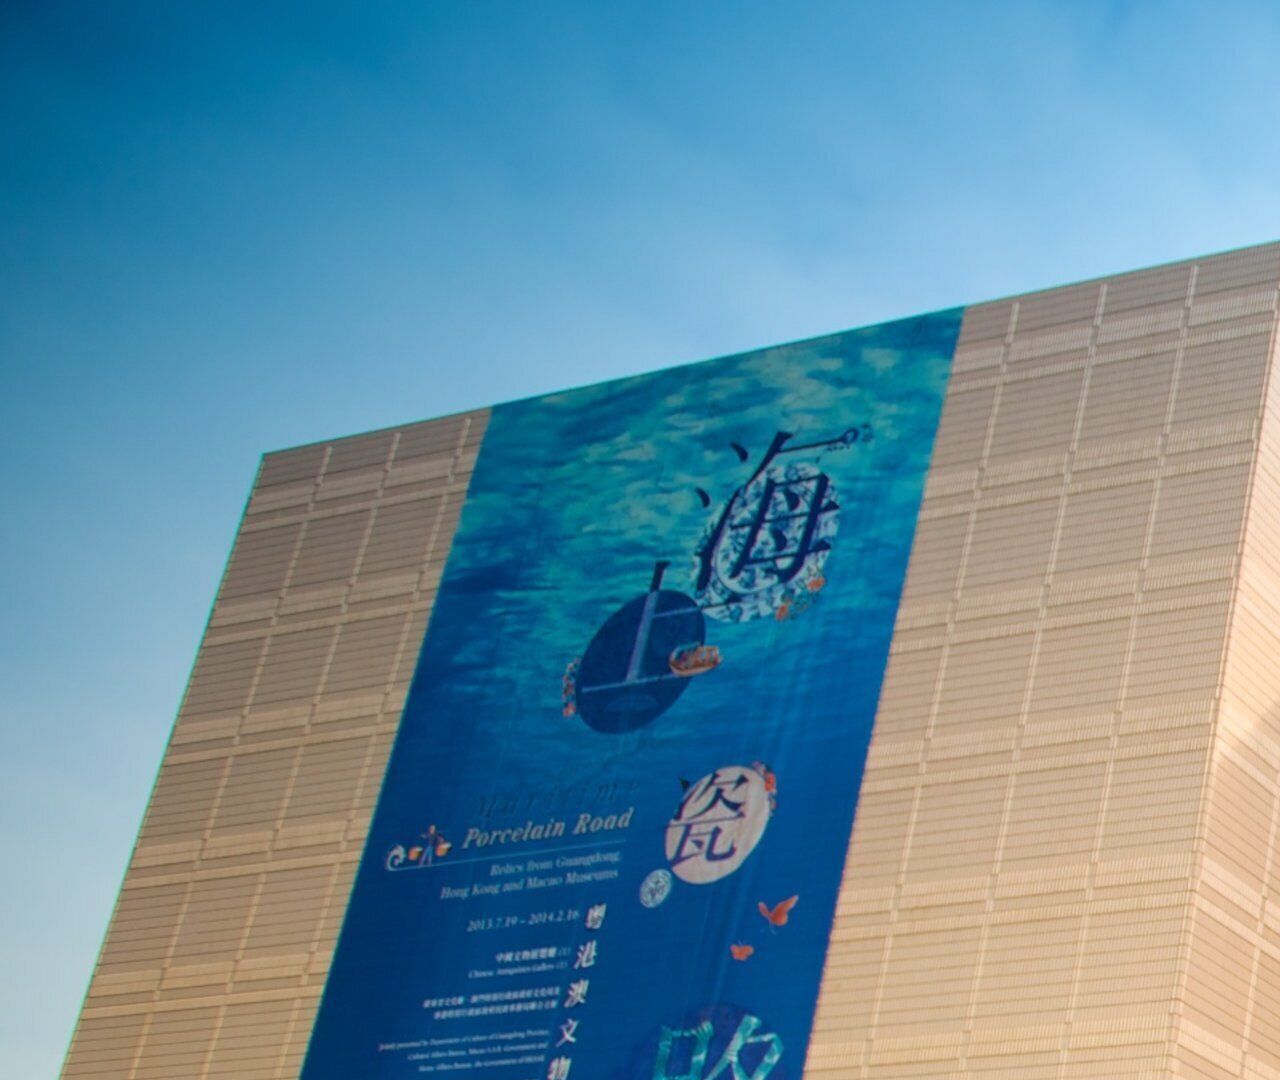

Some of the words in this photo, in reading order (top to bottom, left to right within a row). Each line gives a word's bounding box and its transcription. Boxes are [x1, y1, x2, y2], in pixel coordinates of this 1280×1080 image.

[461, 817, 567, 850] Porcelain
[572, 806, 635, 836] Road
[440, 883, 471, 900] Hong
[471, 879, 501, 897] Kong
